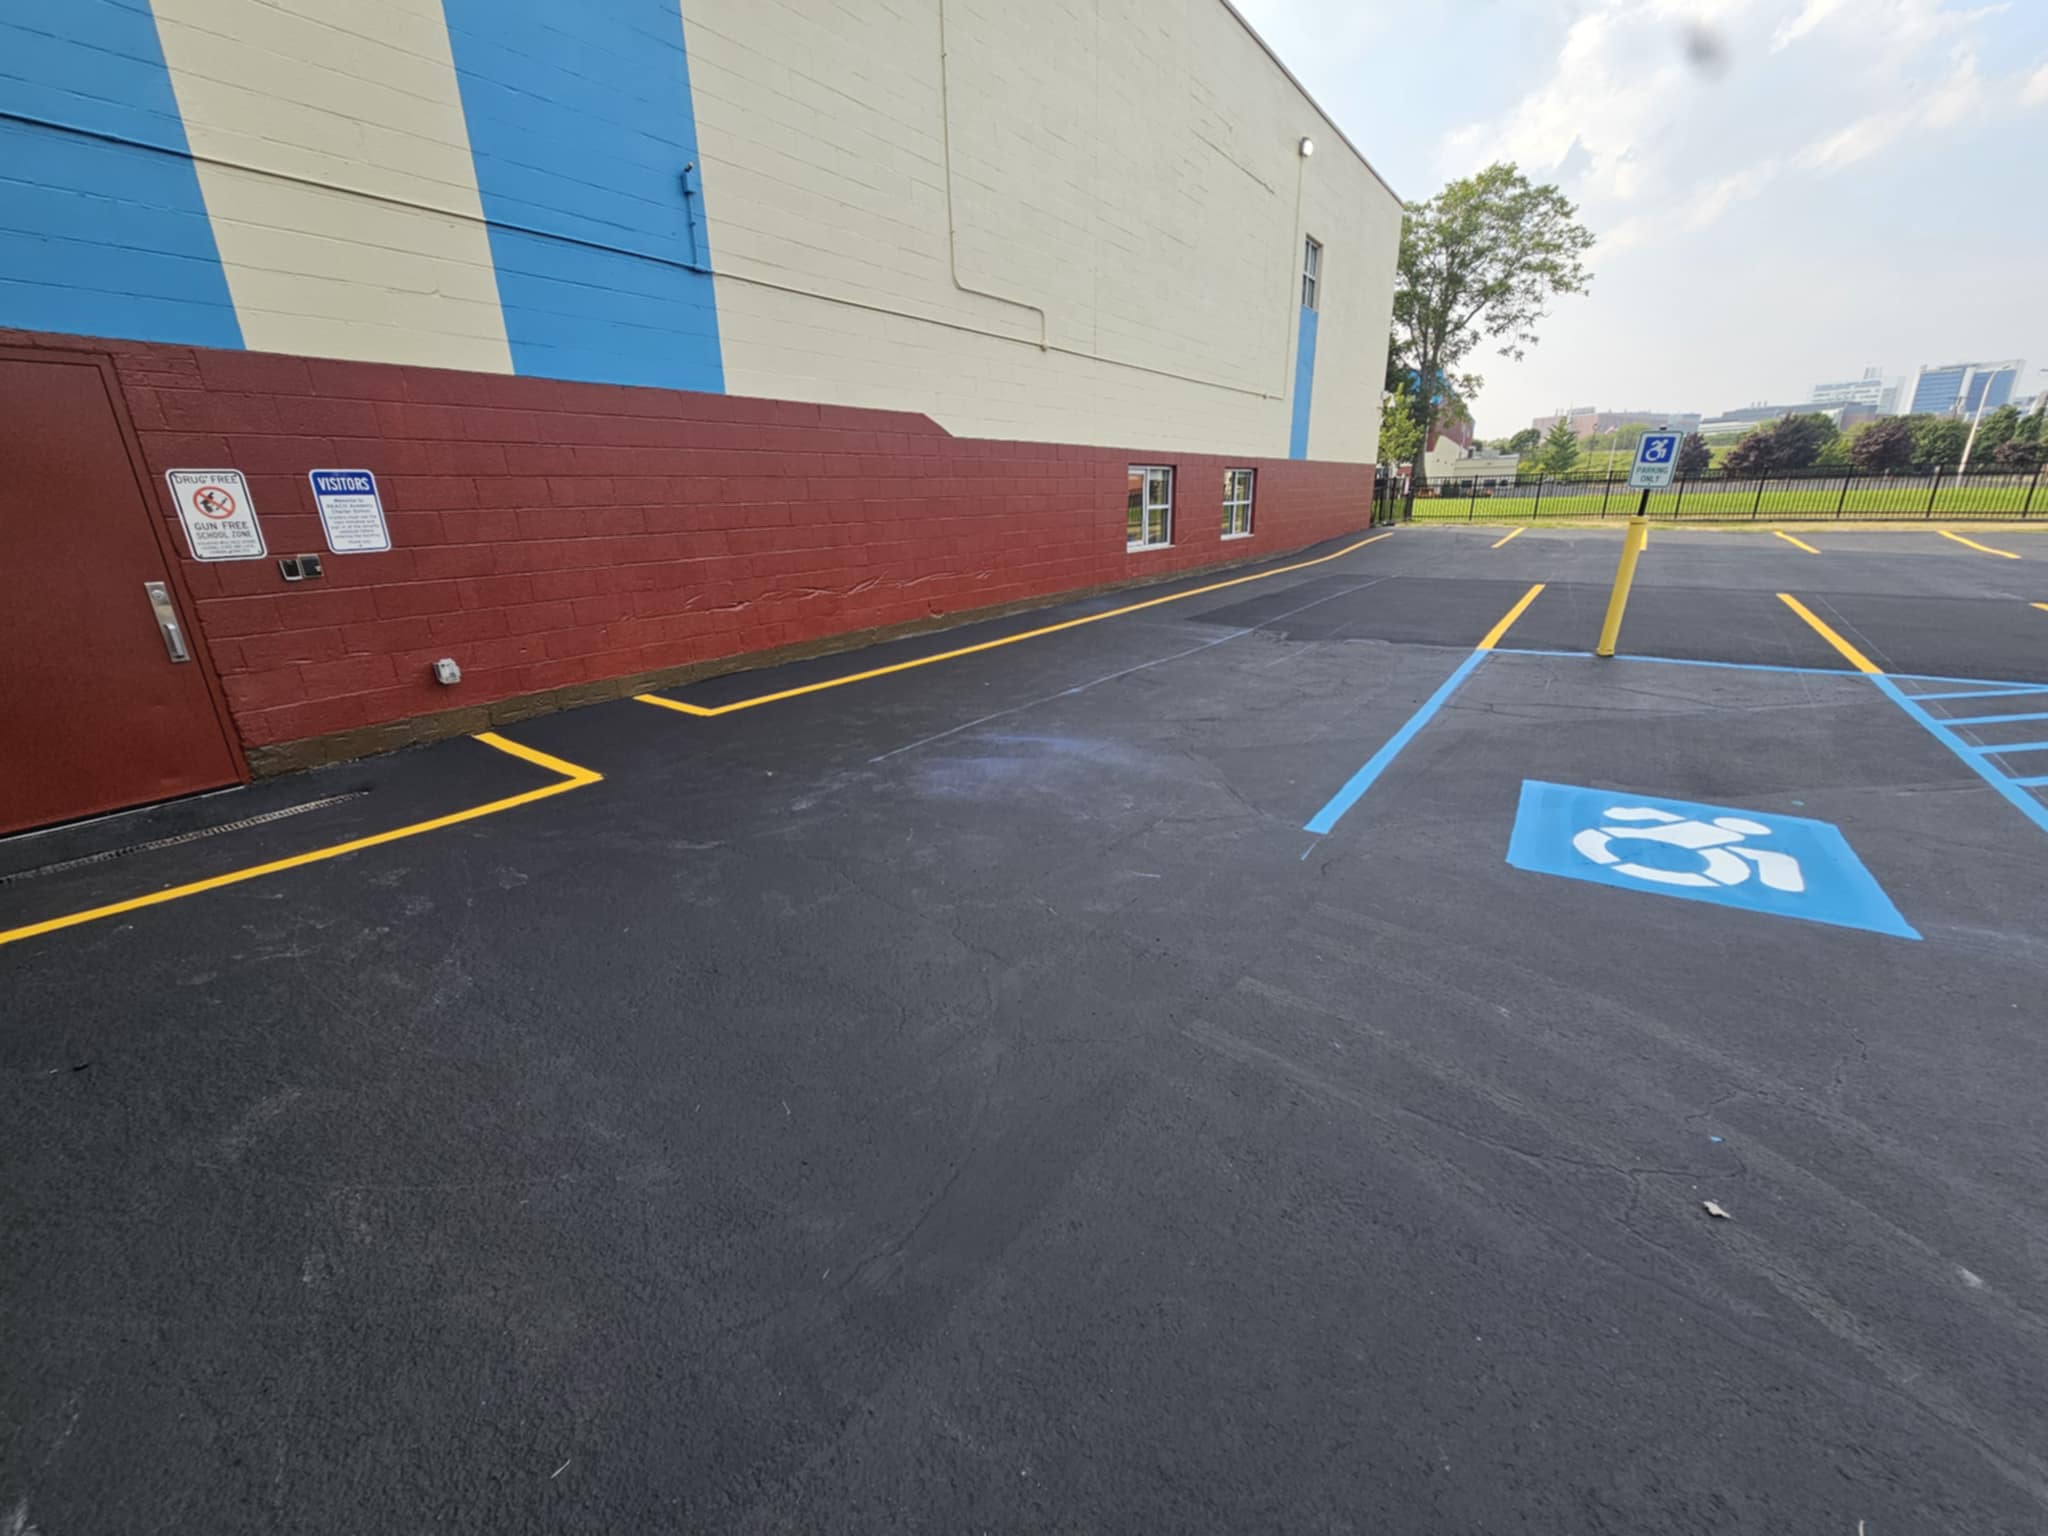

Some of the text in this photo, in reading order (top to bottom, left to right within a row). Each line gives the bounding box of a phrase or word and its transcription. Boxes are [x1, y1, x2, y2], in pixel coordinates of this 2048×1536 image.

[1635, 466, 1669, 474] PARKING
[174, 475, 238, 483] DRUG FREE
[317, 477, 370, 491] VISITORS
[194, 521, 248, 530] GUN FREE
